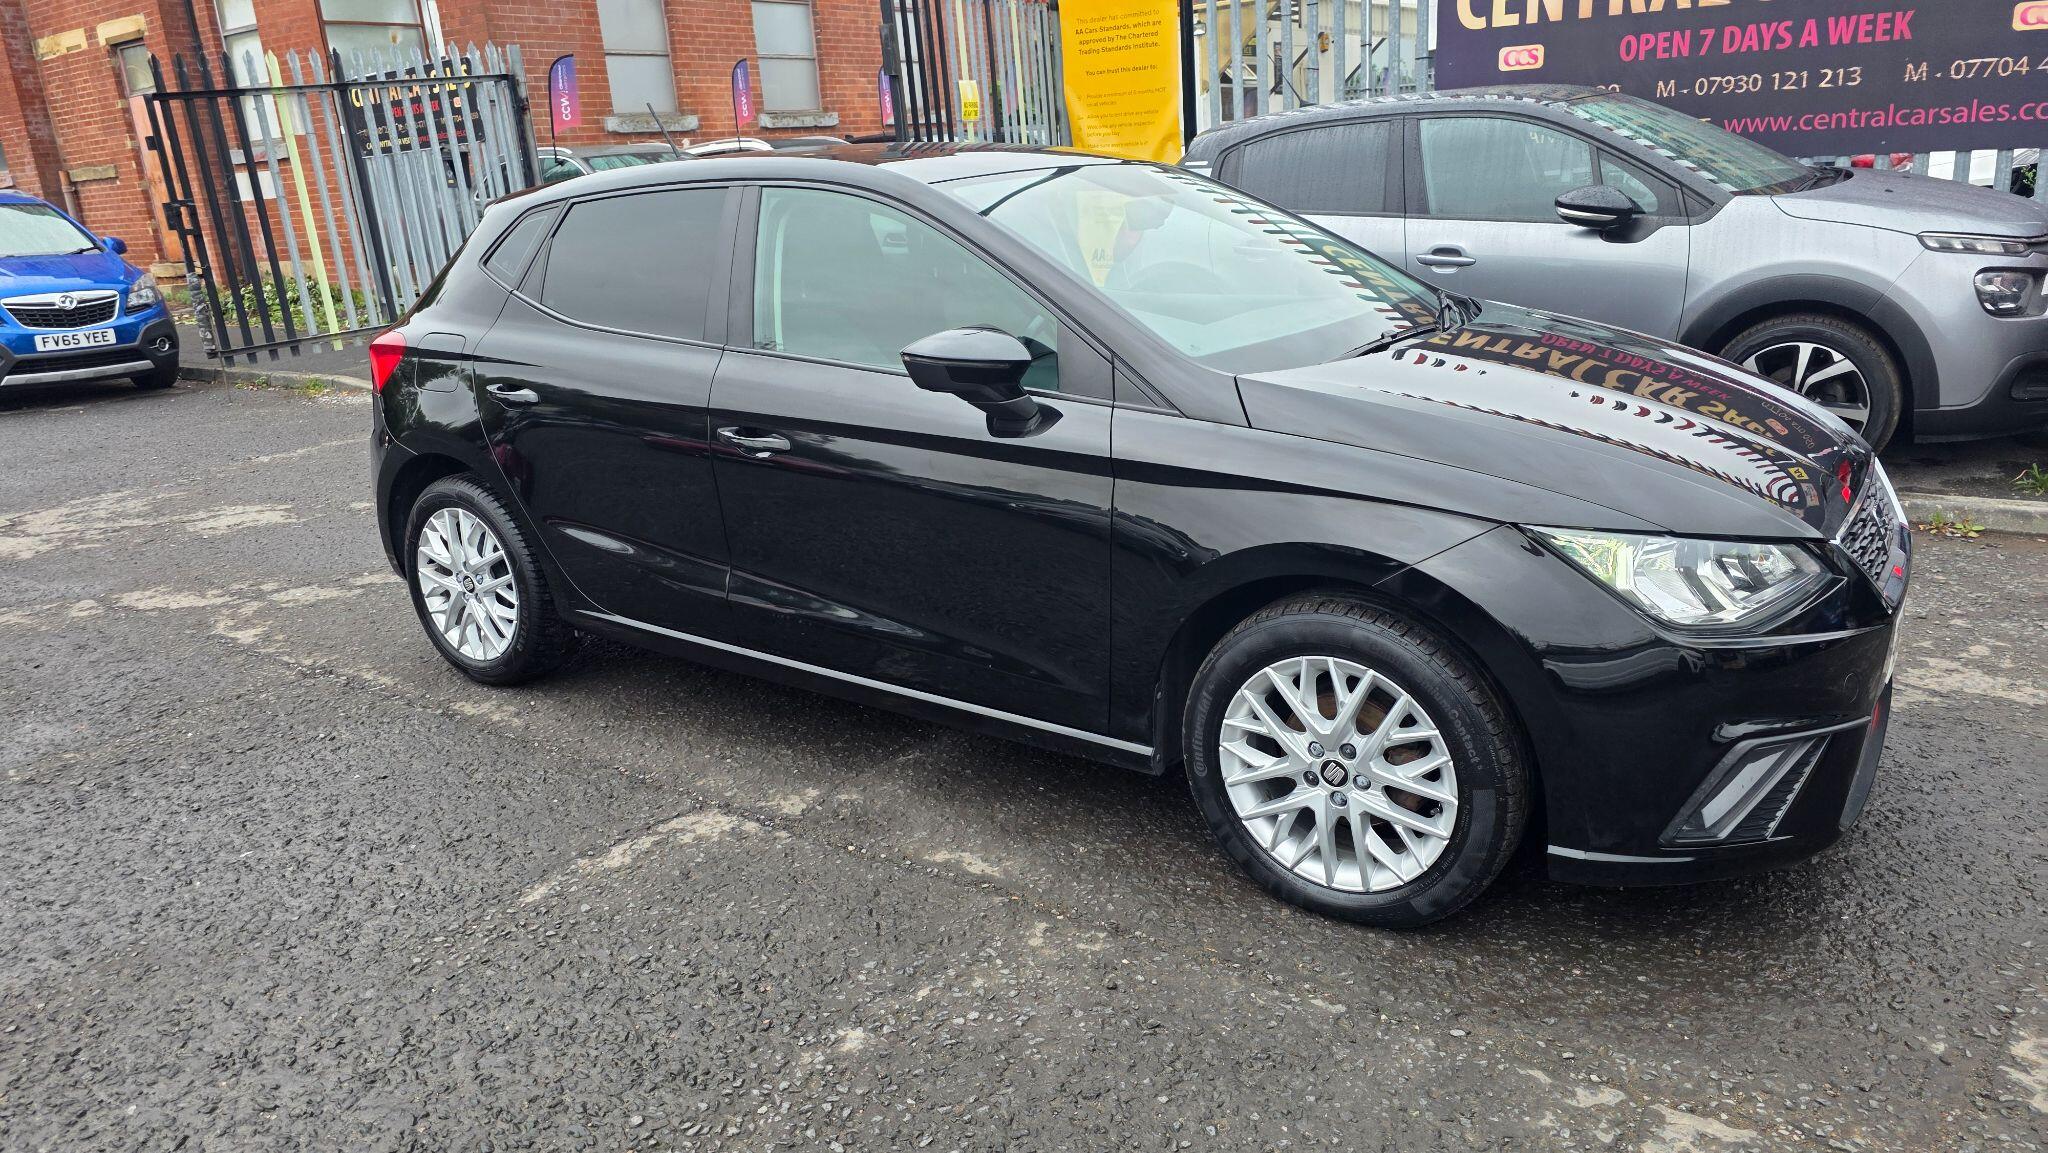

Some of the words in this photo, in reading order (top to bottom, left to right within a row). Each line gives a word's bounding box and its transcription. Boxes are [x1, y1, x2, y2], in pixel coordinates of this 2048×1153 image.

[1076, 17, 1088, 25] This
[1119, 10, 1152, 20] committed
[1099, 24, 1131, 33] Standards,
[1132, 20, 1151, 29] which
[1078, 37, 1107, 46] approved
[1128, 30, 1159, 40] Chartered
[1619, 30, 1691, 62] OPEN
[1699, 29, 1715, 56] 7
[1722, 20, 1793, 54] DAYS
[1799, 19, 1819, 48] A
[1828, 10, 1916, 46] WEEK
[1078, 47, 1100, 56] Trading
[1101, 44, 1132, 53] Standards
[1502, 48, 1540, 67] CCS
[1106, 67, 1120, 75] trust
[1131, 64, 1149, 72] dealer
[1904, 61, 1928, 82] M
[1950, 56, 2030, 80] 07704
[1656, 79, 1676, 98] M
[1694, 74, 1762, 96] 07930
[1771, 70, 1809, 92] 121
[1818, 66, 1863, 88] 213
[42, 333, 80, 349] FV65
[84, 330, 111, 344] YEE
